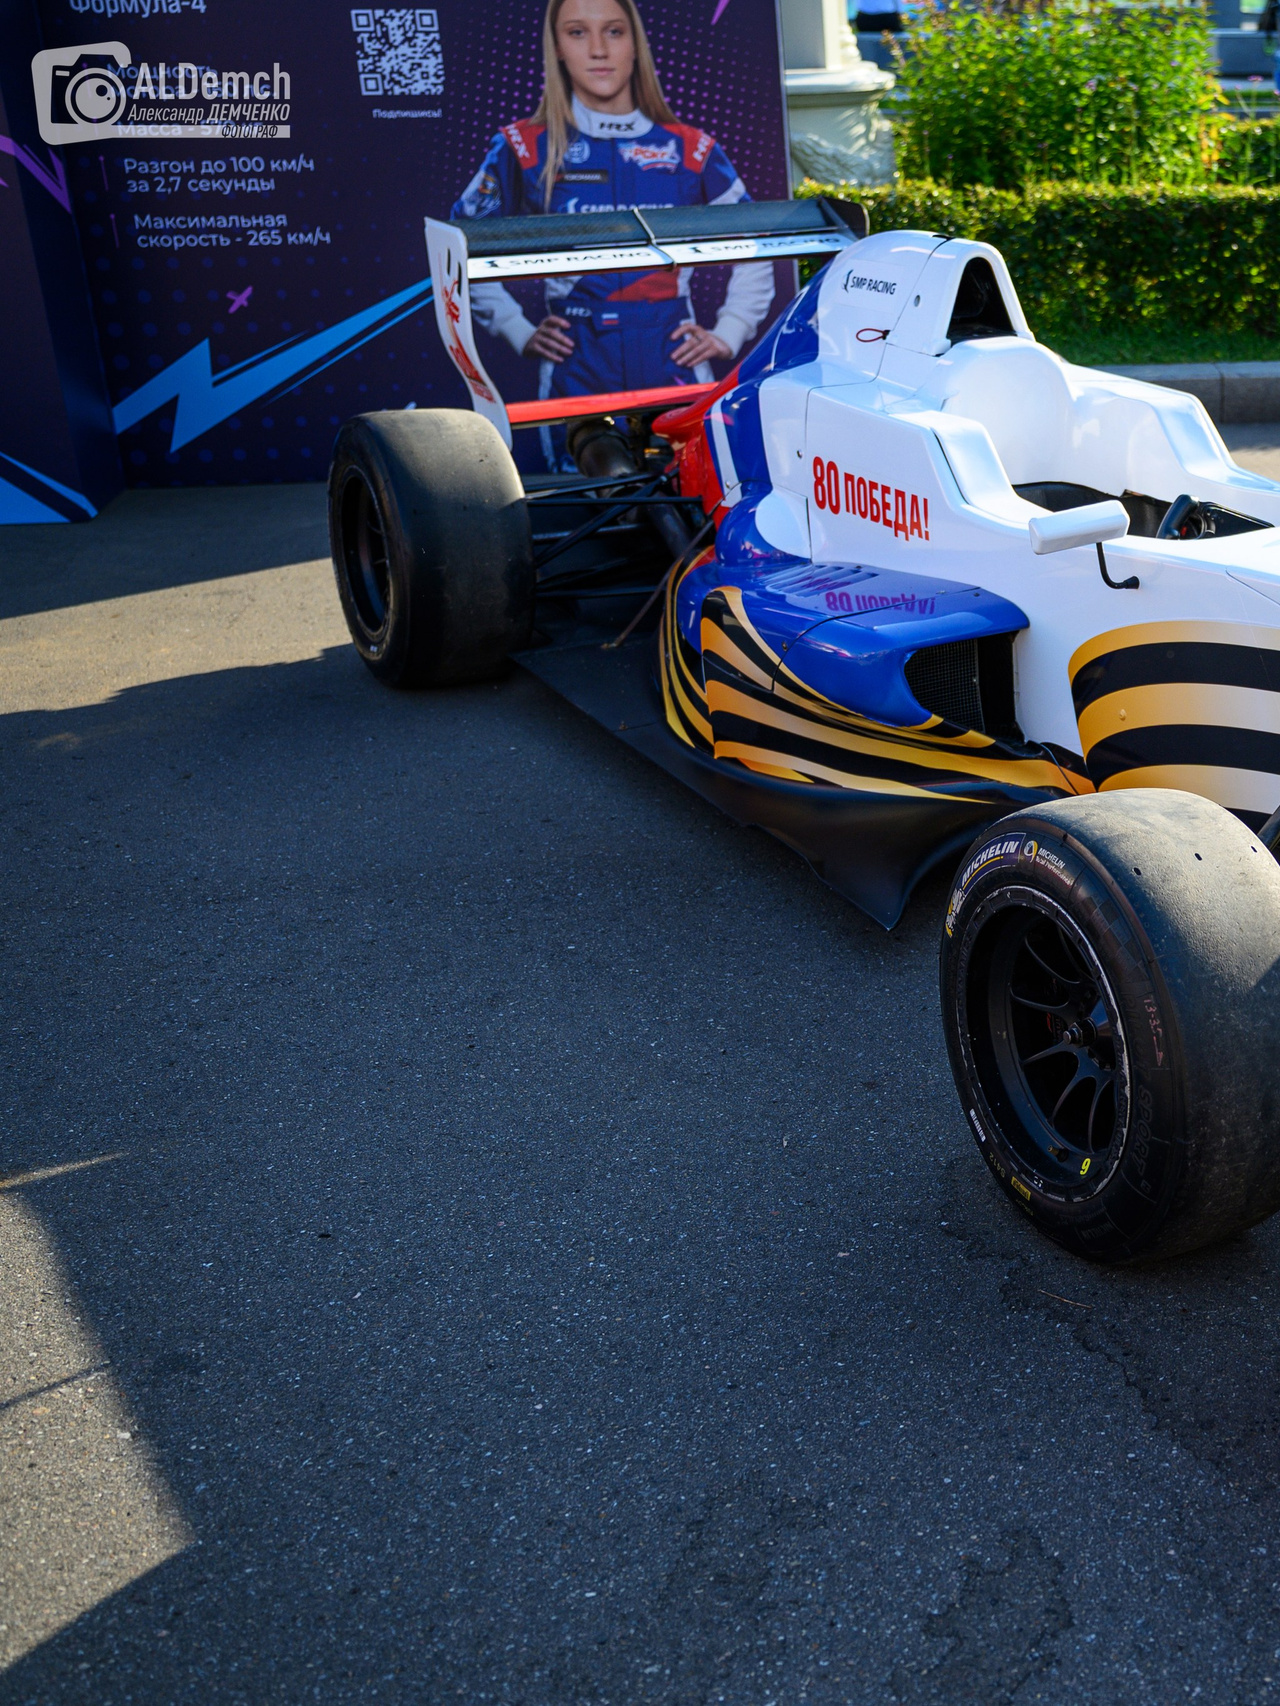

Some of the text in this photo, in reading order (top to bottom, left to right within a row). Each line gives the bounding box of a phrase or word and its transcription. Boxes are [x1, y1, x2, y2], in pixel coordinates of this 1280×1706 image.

[599, 121, 636, 132] HRX
[124, 153, 315, 175] Разгон до 100 км/ч
[127, 177, 275, 195] за 2,7 секунды
[134, 213, 288, 230] Максимальная
[137, 234, 231, 250] скорость
[247, 229, 283, 246] 265
[287, 226, 332, 246] км/ч
[508, 250, 652, 267] SMP RACING
[711, 243, 757, 255] SMP
[850, 275, 897, 296] SMP RACING
[812, 456, 930, 541] 80 ПОБЕДА!
[961, 841, 1020, 887] MICHELIN
[1037, 848, 1066, 869] MICHELIN
